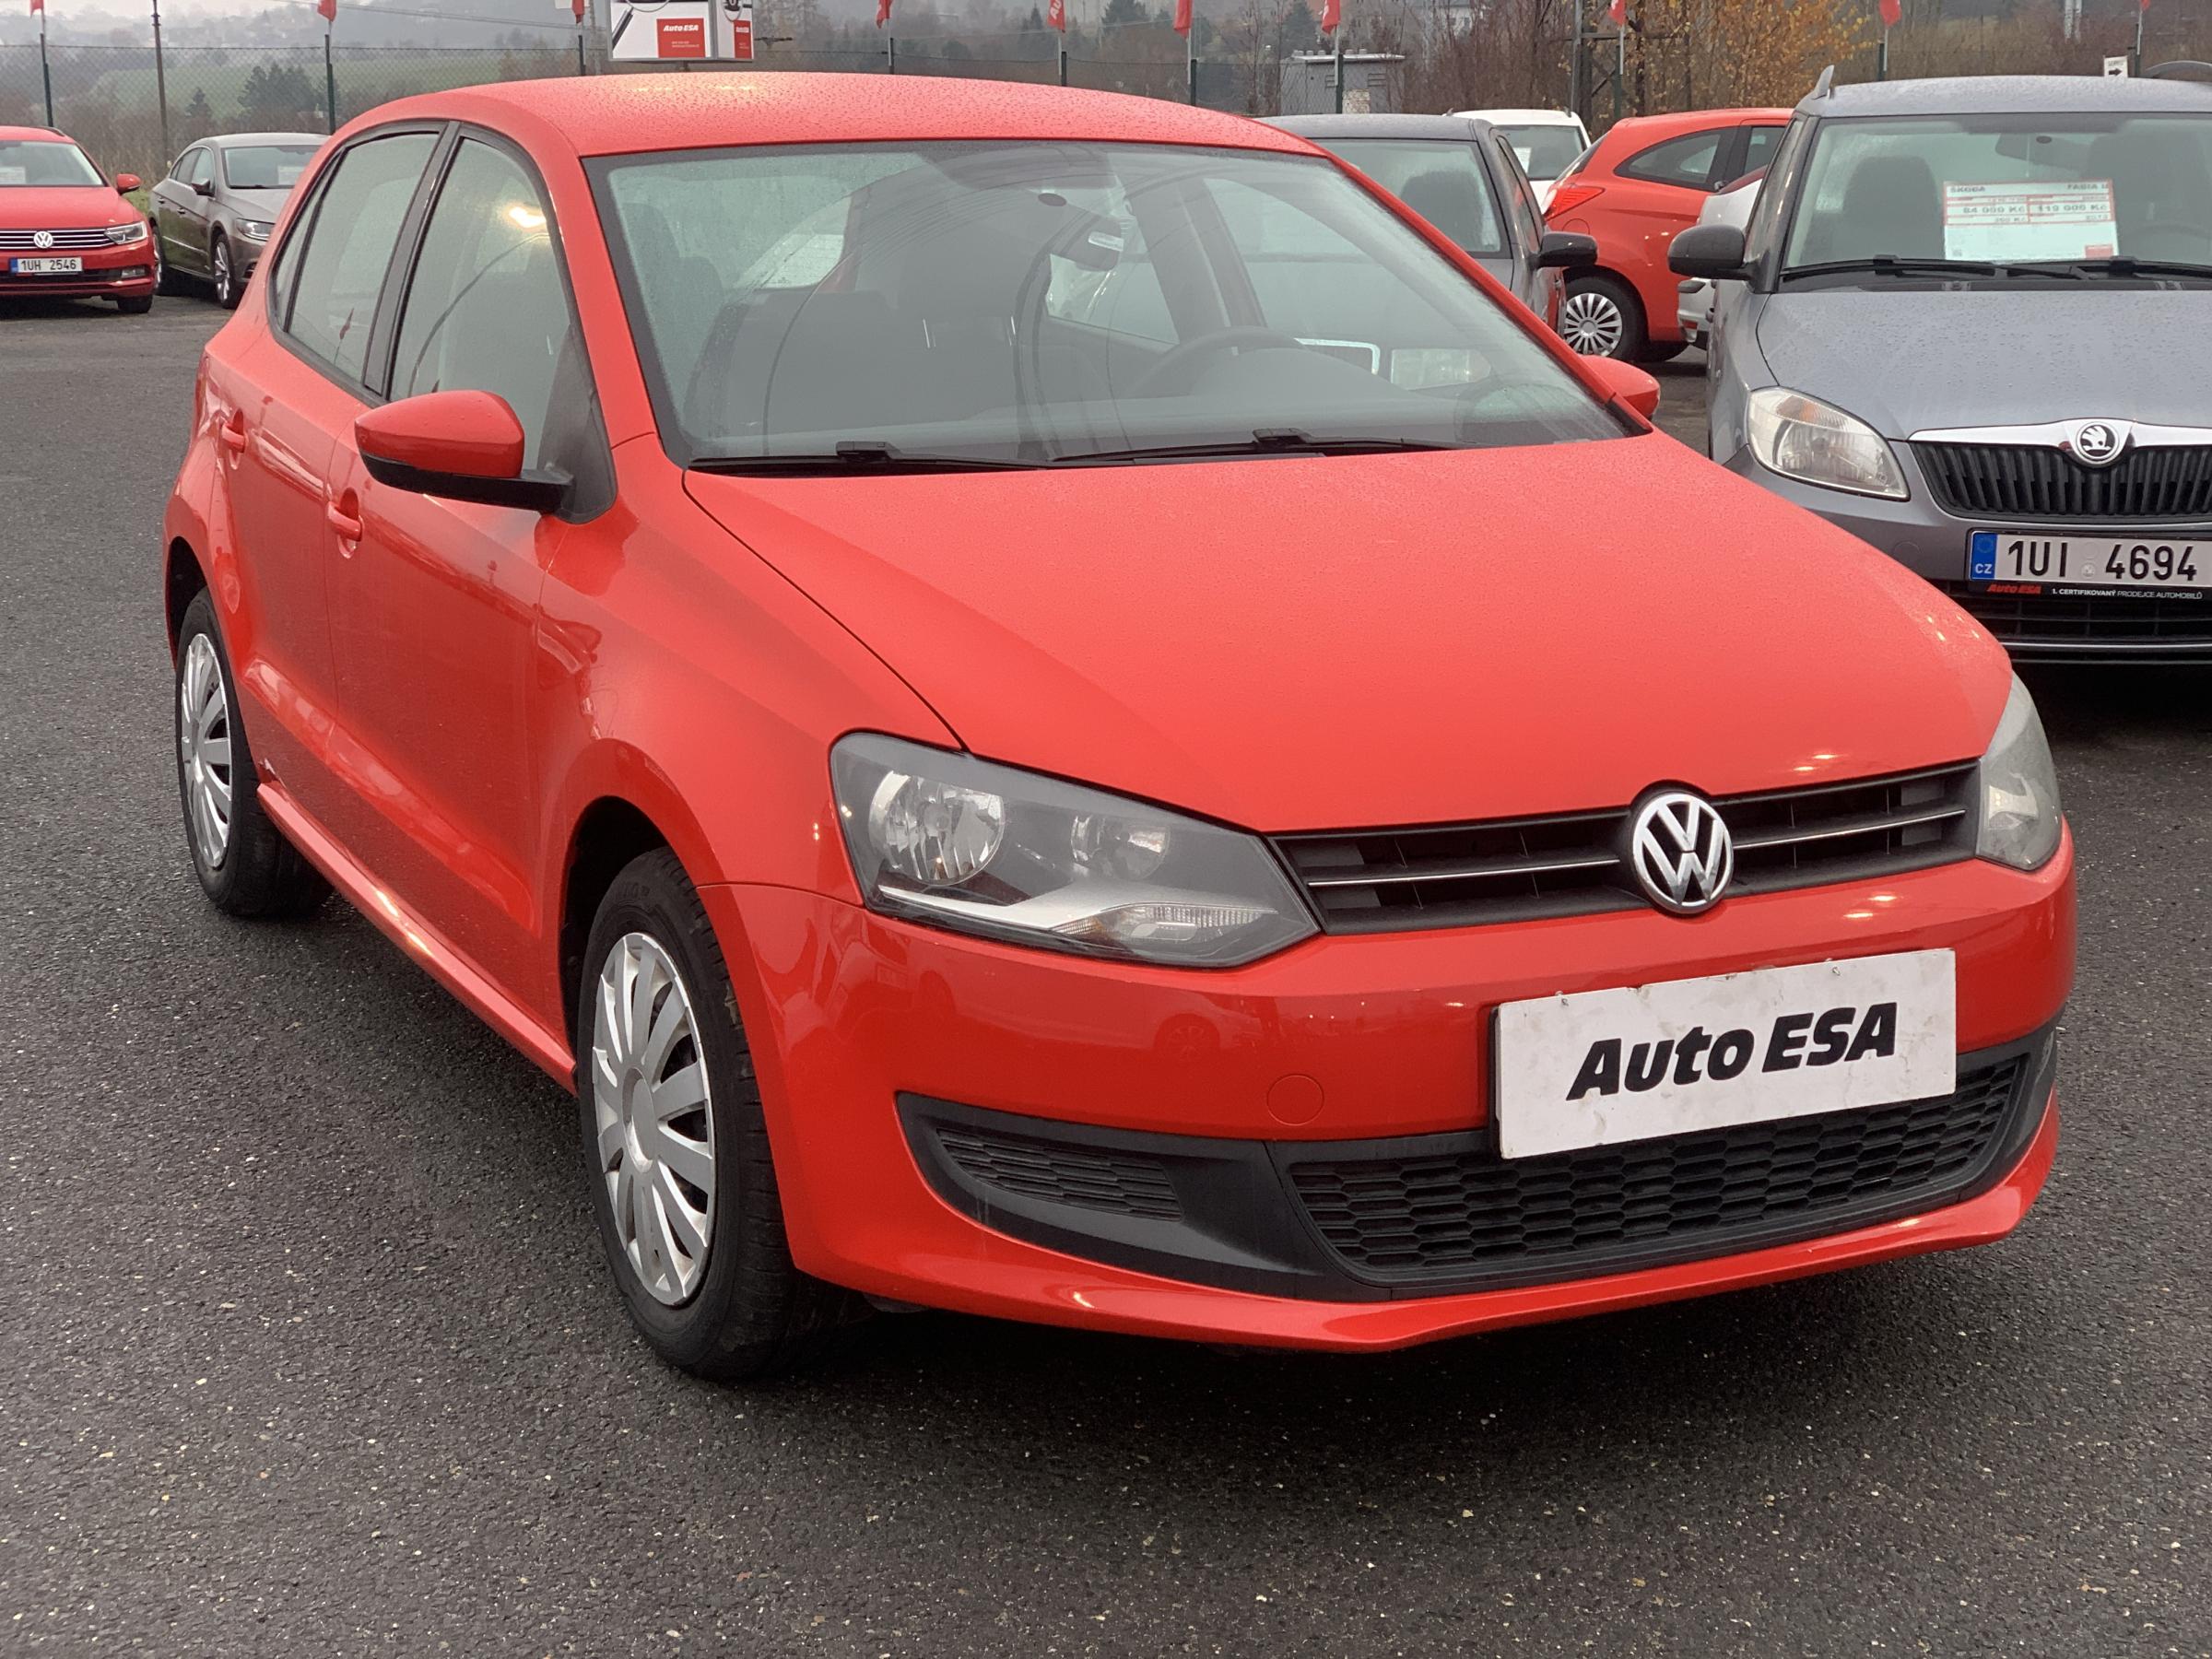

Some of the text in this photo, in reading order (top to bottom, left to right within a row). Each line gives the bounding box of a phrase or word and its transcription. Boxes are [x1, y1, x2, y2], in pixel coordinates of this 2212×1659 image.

[20, 260, 41, 271] 1UH
[50, 259, 76, 270] 2546
[2007, 540, 2197, 582] 1UI 4694
[1975, 562, 1993, 575] CZ
[1986, 583, 2042, 594] Auto ESA
[2058, 588, 2116, 597] CERTIFIKOVANÝ
[2117, 590, 2155, 598] PRODEJCE
[2156, 591, 2203, 599] AUTOMOBILŮ
[1566, 1002, 1898, 1101] Auto ESA
